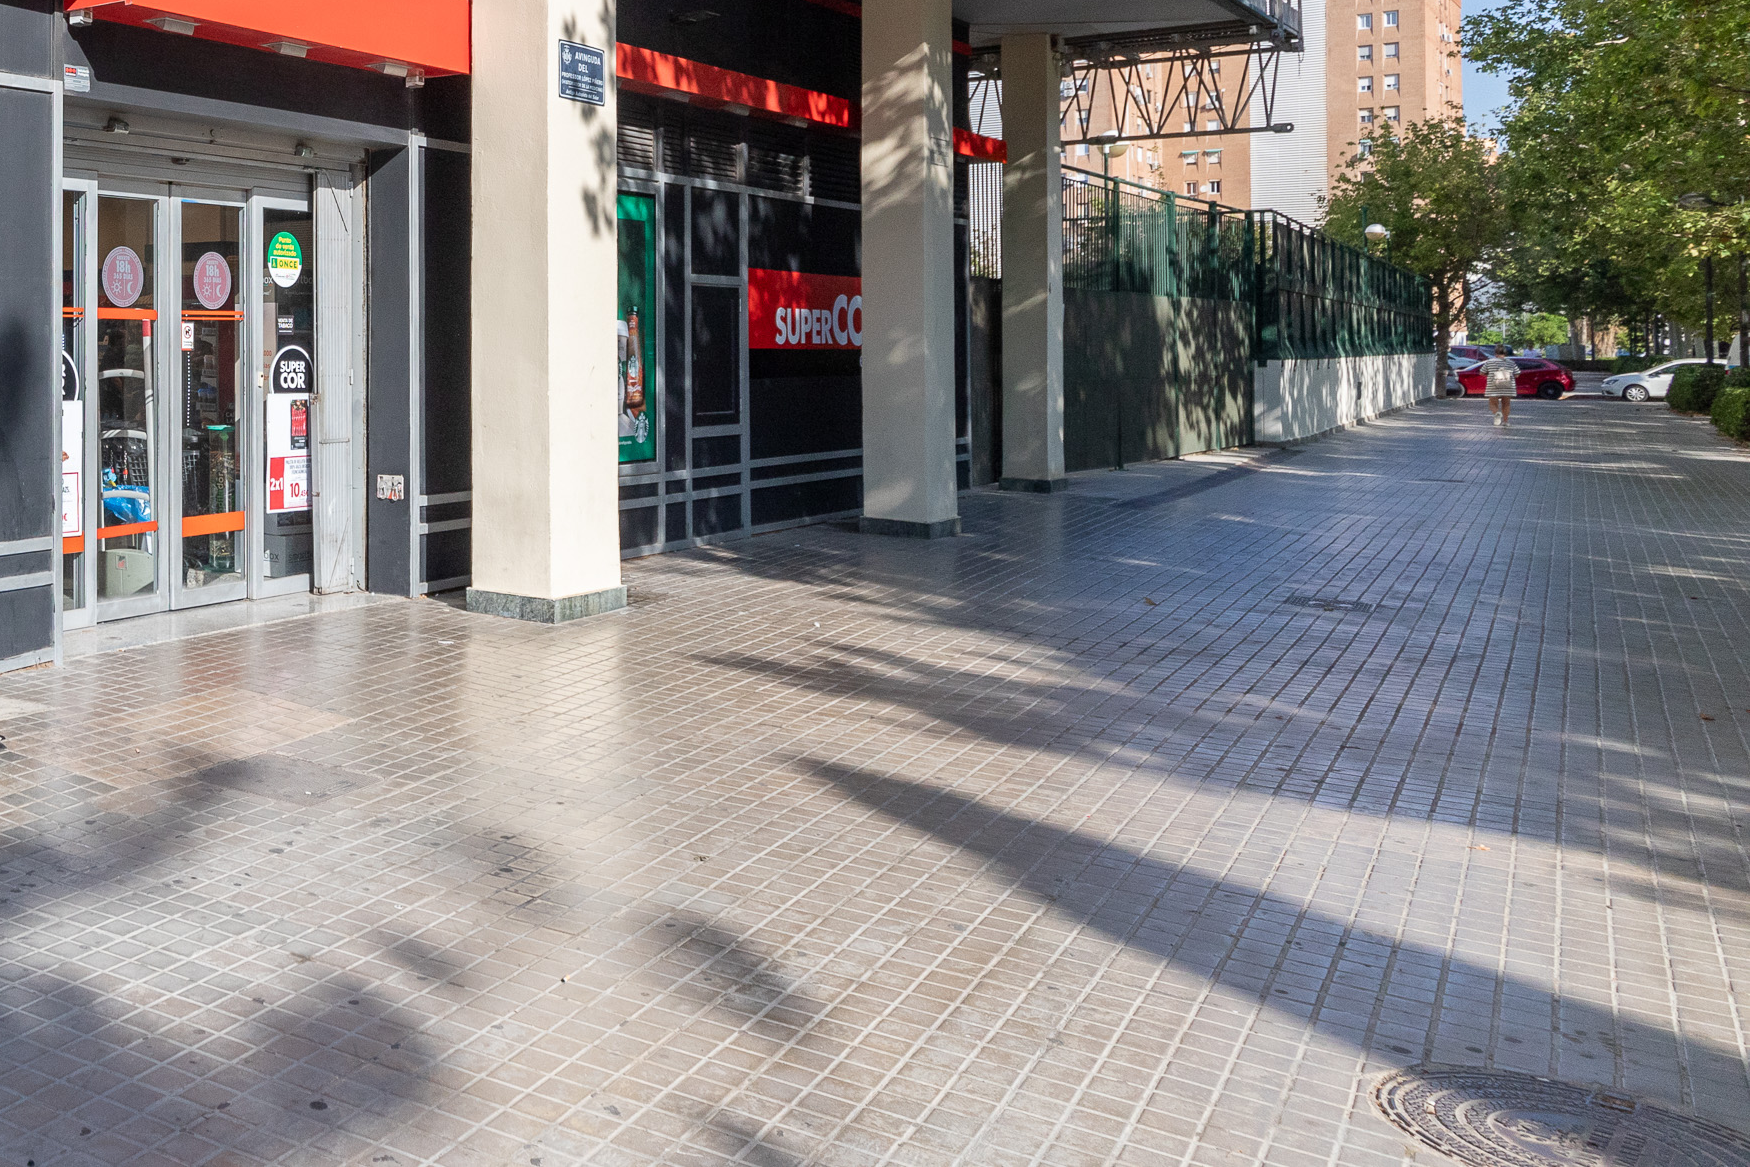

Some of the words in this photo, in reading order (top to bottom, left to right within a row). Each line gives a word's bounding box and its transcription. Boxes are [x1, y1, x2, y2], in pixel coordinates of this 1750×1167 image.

[575, 51, 601, 65] AVINGUDA
[578, 63, 588, 73] DEL
[116, 260, 131, 273] 18h
[205, 264, 219, 277] 18h
[279, 259, 298, 269] ONCE
[775, 294, 862, 347] SUPERCO
[279, 360, 306, 373] SUPER
[280, 373, 306, 389] COR
[270, 477, 284, 491] 2x1
